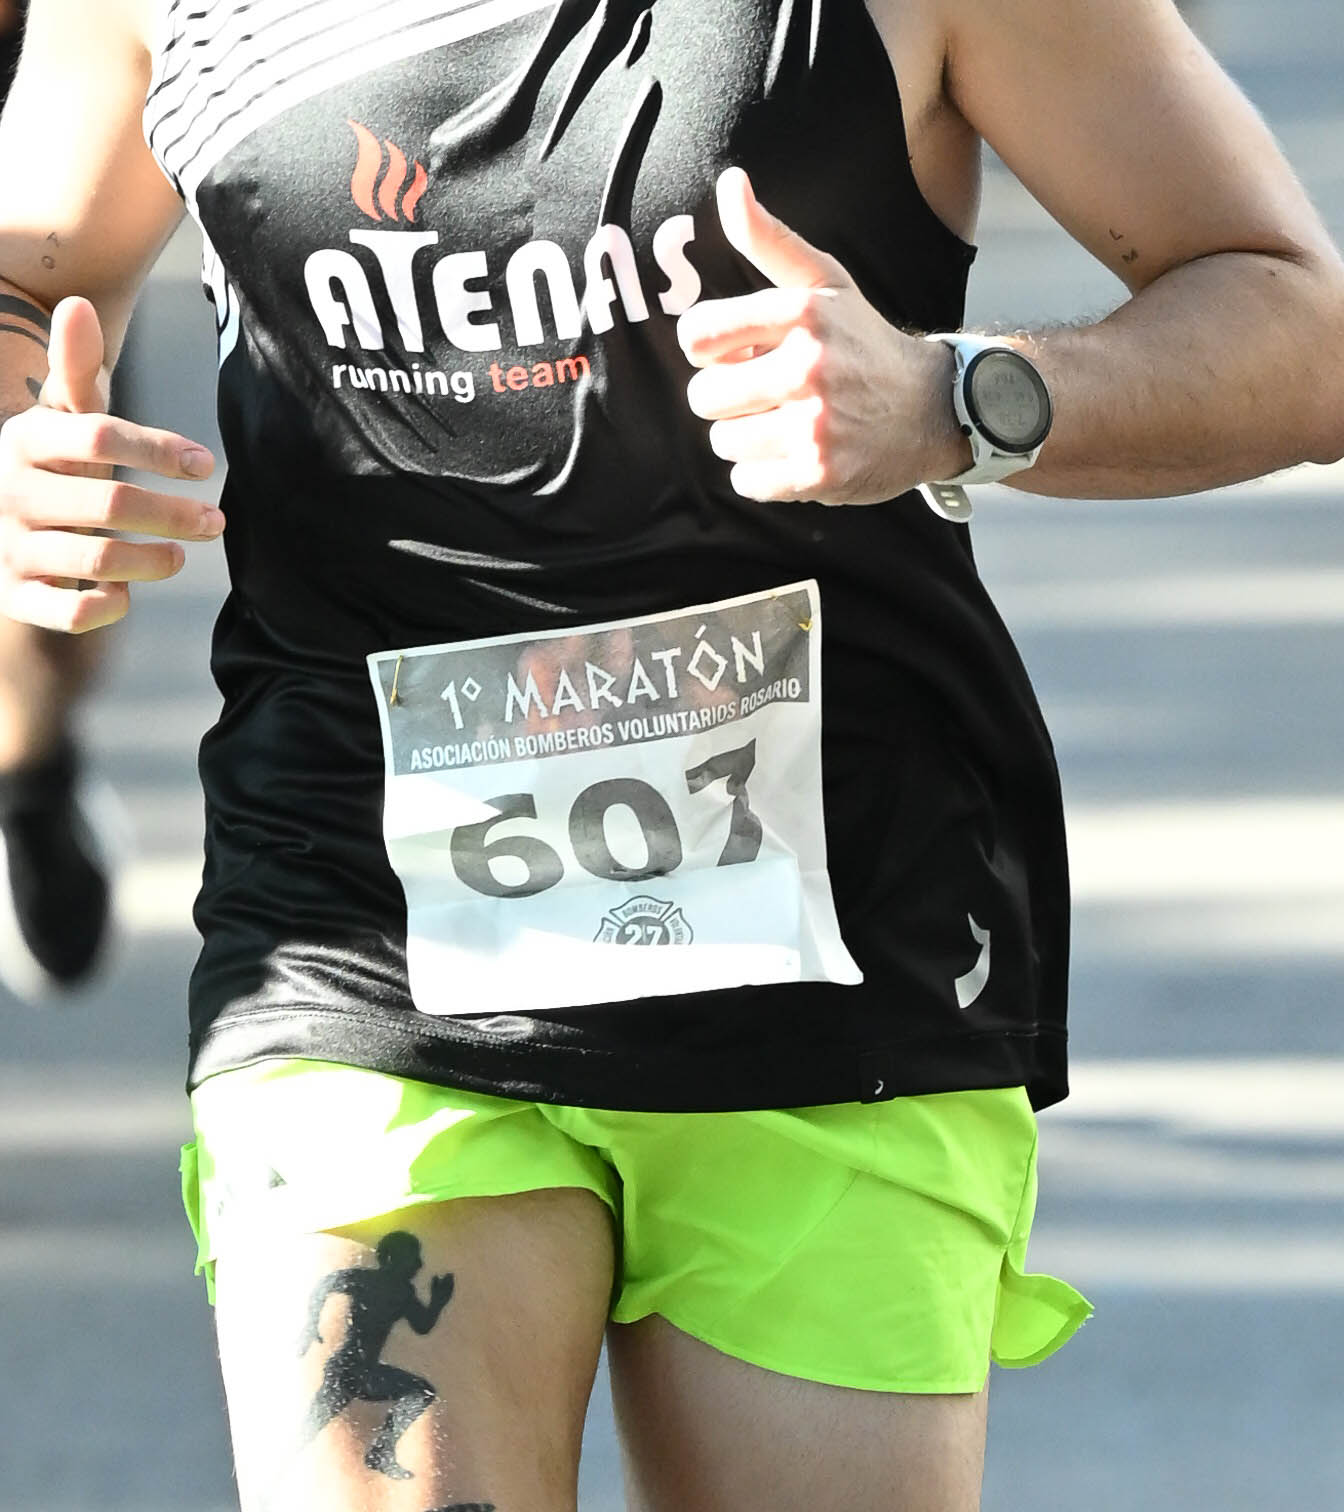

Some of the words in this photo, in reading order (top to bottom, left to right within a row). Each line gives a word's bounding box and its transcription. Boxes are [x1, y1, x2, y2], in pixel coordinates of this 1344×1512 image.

[304, 215, 701, 352] ATENAS
[332, 363, 476, 403] running
[488, 354, 591, 393] team
[505, 625, 766, 723] MARATÓN
[410, 735, 511, 771] ASOCIACIÓN
[515, 725, 615, 757] BOMBEROS
[617, 701, 736, 742] VOLUNTARIOS
[740, 677, 802, 716] ROSARIO
[450, 738, 763, 898] 607
